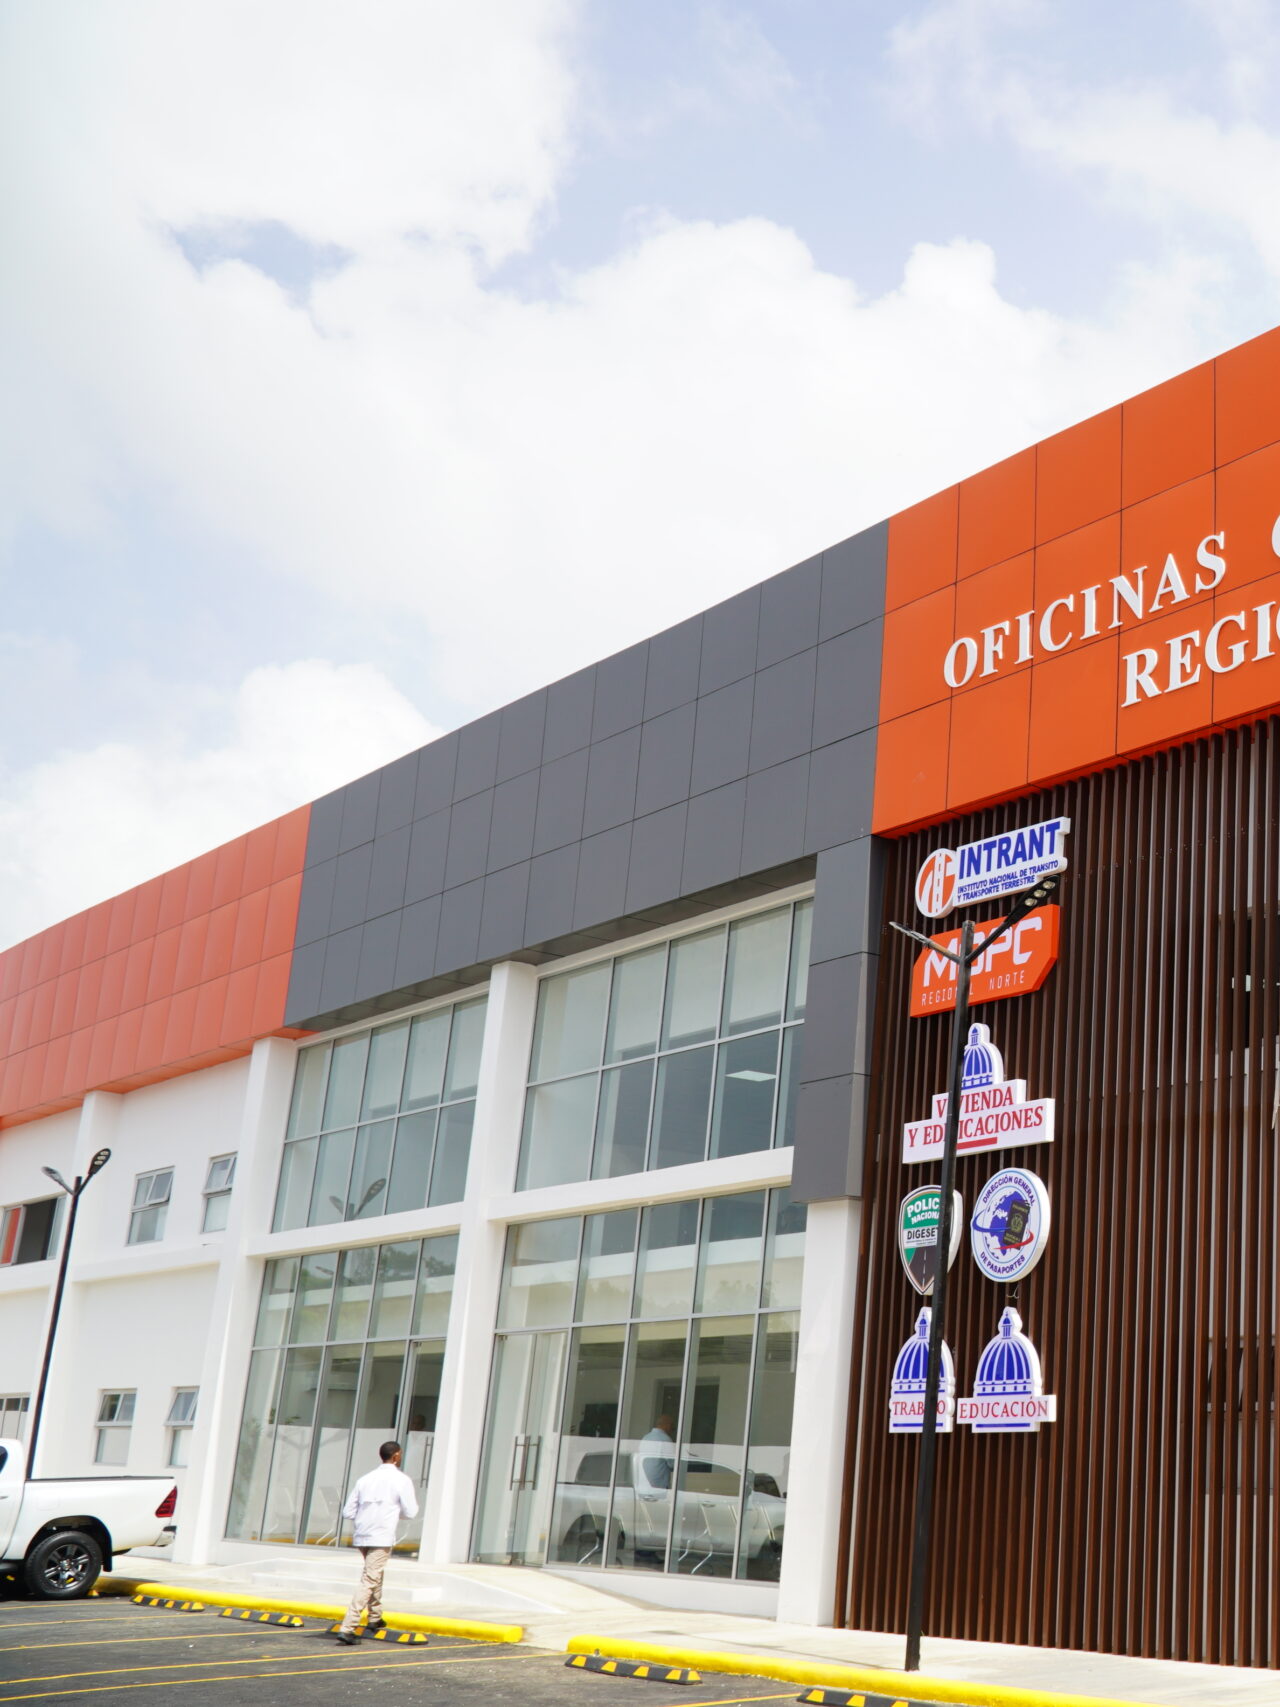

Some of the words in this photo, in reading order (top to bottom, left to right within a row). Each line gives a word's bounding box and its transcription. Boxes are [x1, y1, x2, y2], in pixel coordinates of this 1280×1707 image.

[943, 530, 1227, 688] OFICINAS
[958, 820, 1061, 880] INTRANT
[957, 879, 988, 894] INSTITUTO
[988, 871, 1018, 885] NACIONAL
[1019, 868, 1028, 877] DE
[957, 894, 961, 903] Y
[962, 885, 1000, 900] TRANSPORTE
[1001, 875, 1035, 891] TERRESTRE
[921, 983, 974, 1007] REGIOL
[989, 969, 1026, 991] NORTE
[936, 1086, 1014, 1119] VIENDA
[908, 1127, 919, 1148] Y
[923, 1105, 1044, 1146] EDICACIONES
[1013, 1176, 1036, 1206] GENERAL
[906, 1197, 940, 1218] POLIC
[980, 1251, 989, 1263] DE
[987, 1254, 1026, 1275] PASAPORTES
[892, 1400, 946, 1416] TRABO
[959, 1395, 1048, 1419] EDUCACIÓN
